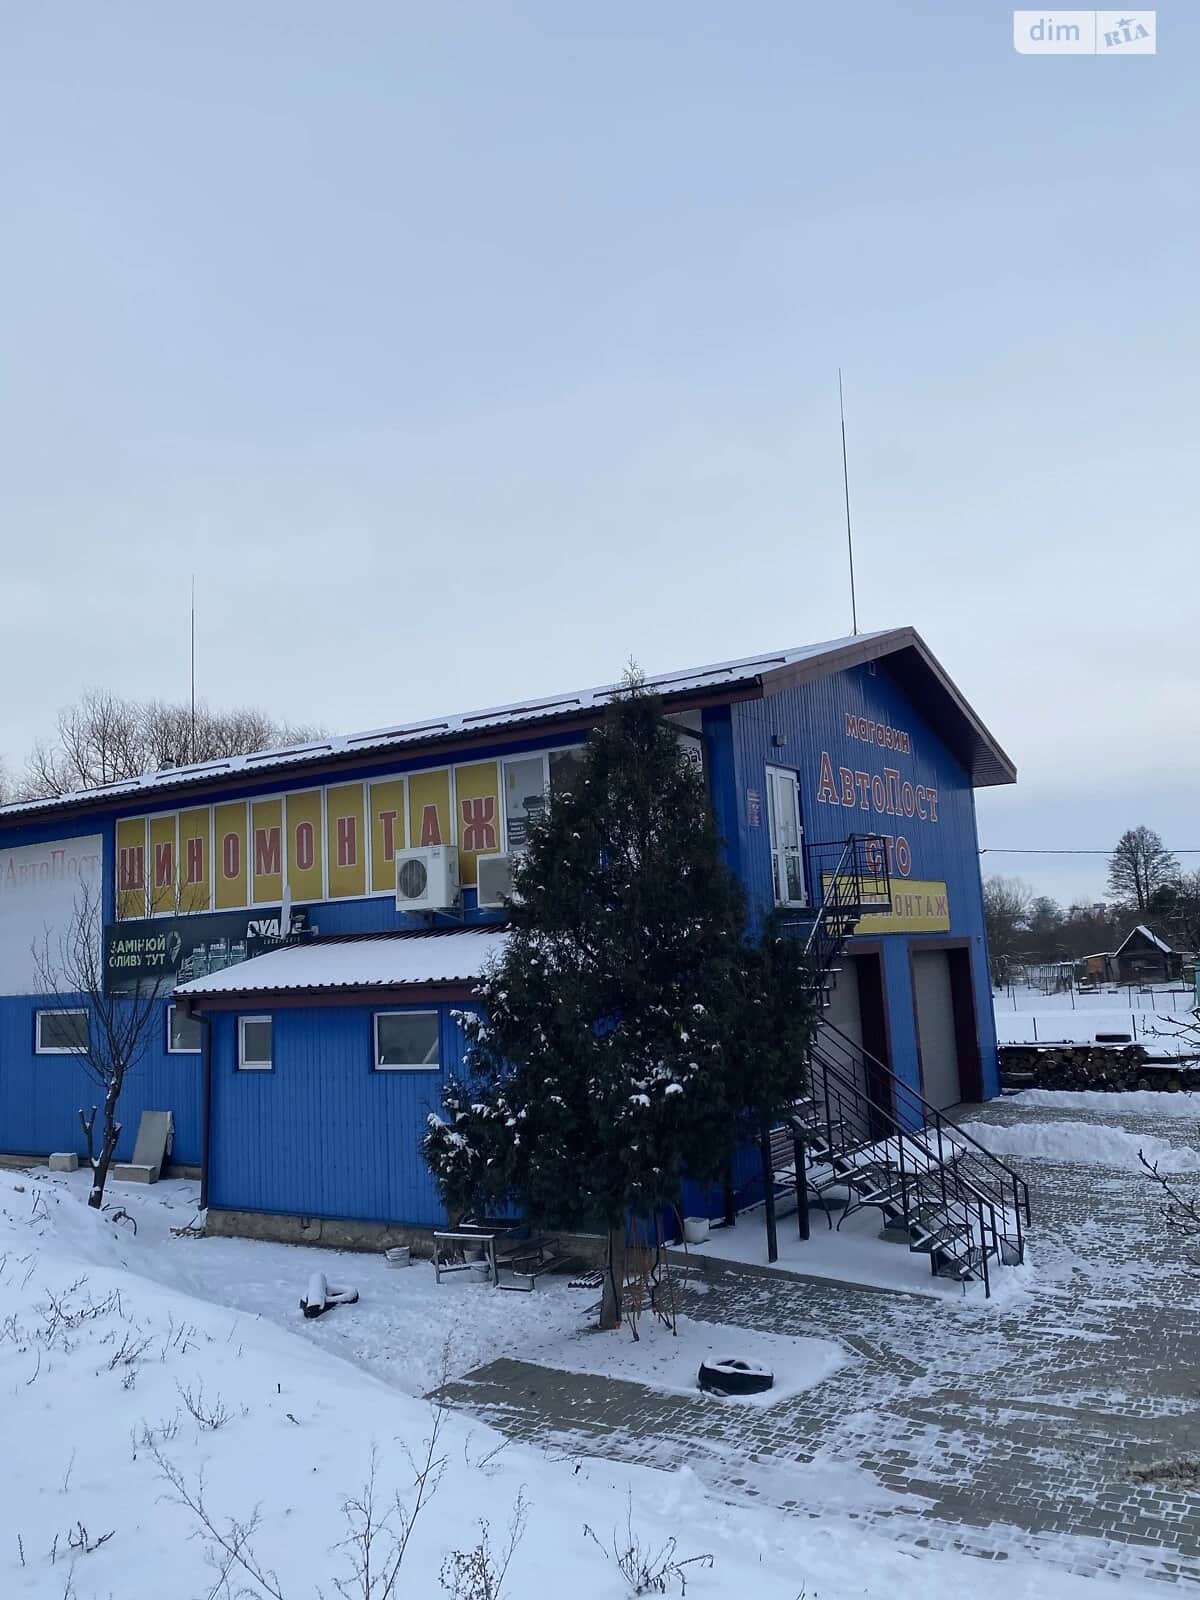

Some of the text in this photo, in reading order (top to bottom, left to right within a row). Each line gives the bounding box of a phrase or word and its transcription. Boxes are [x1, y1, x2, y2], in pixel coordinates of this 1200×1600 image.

[845, 712, 910, 753] магазин
[119, 797, 498, 892] ШИНОМОНТАЖ
[864, 832, 912, 877] СТО
[109, 953, 166, 968] ОЛИВУ ТУТ
